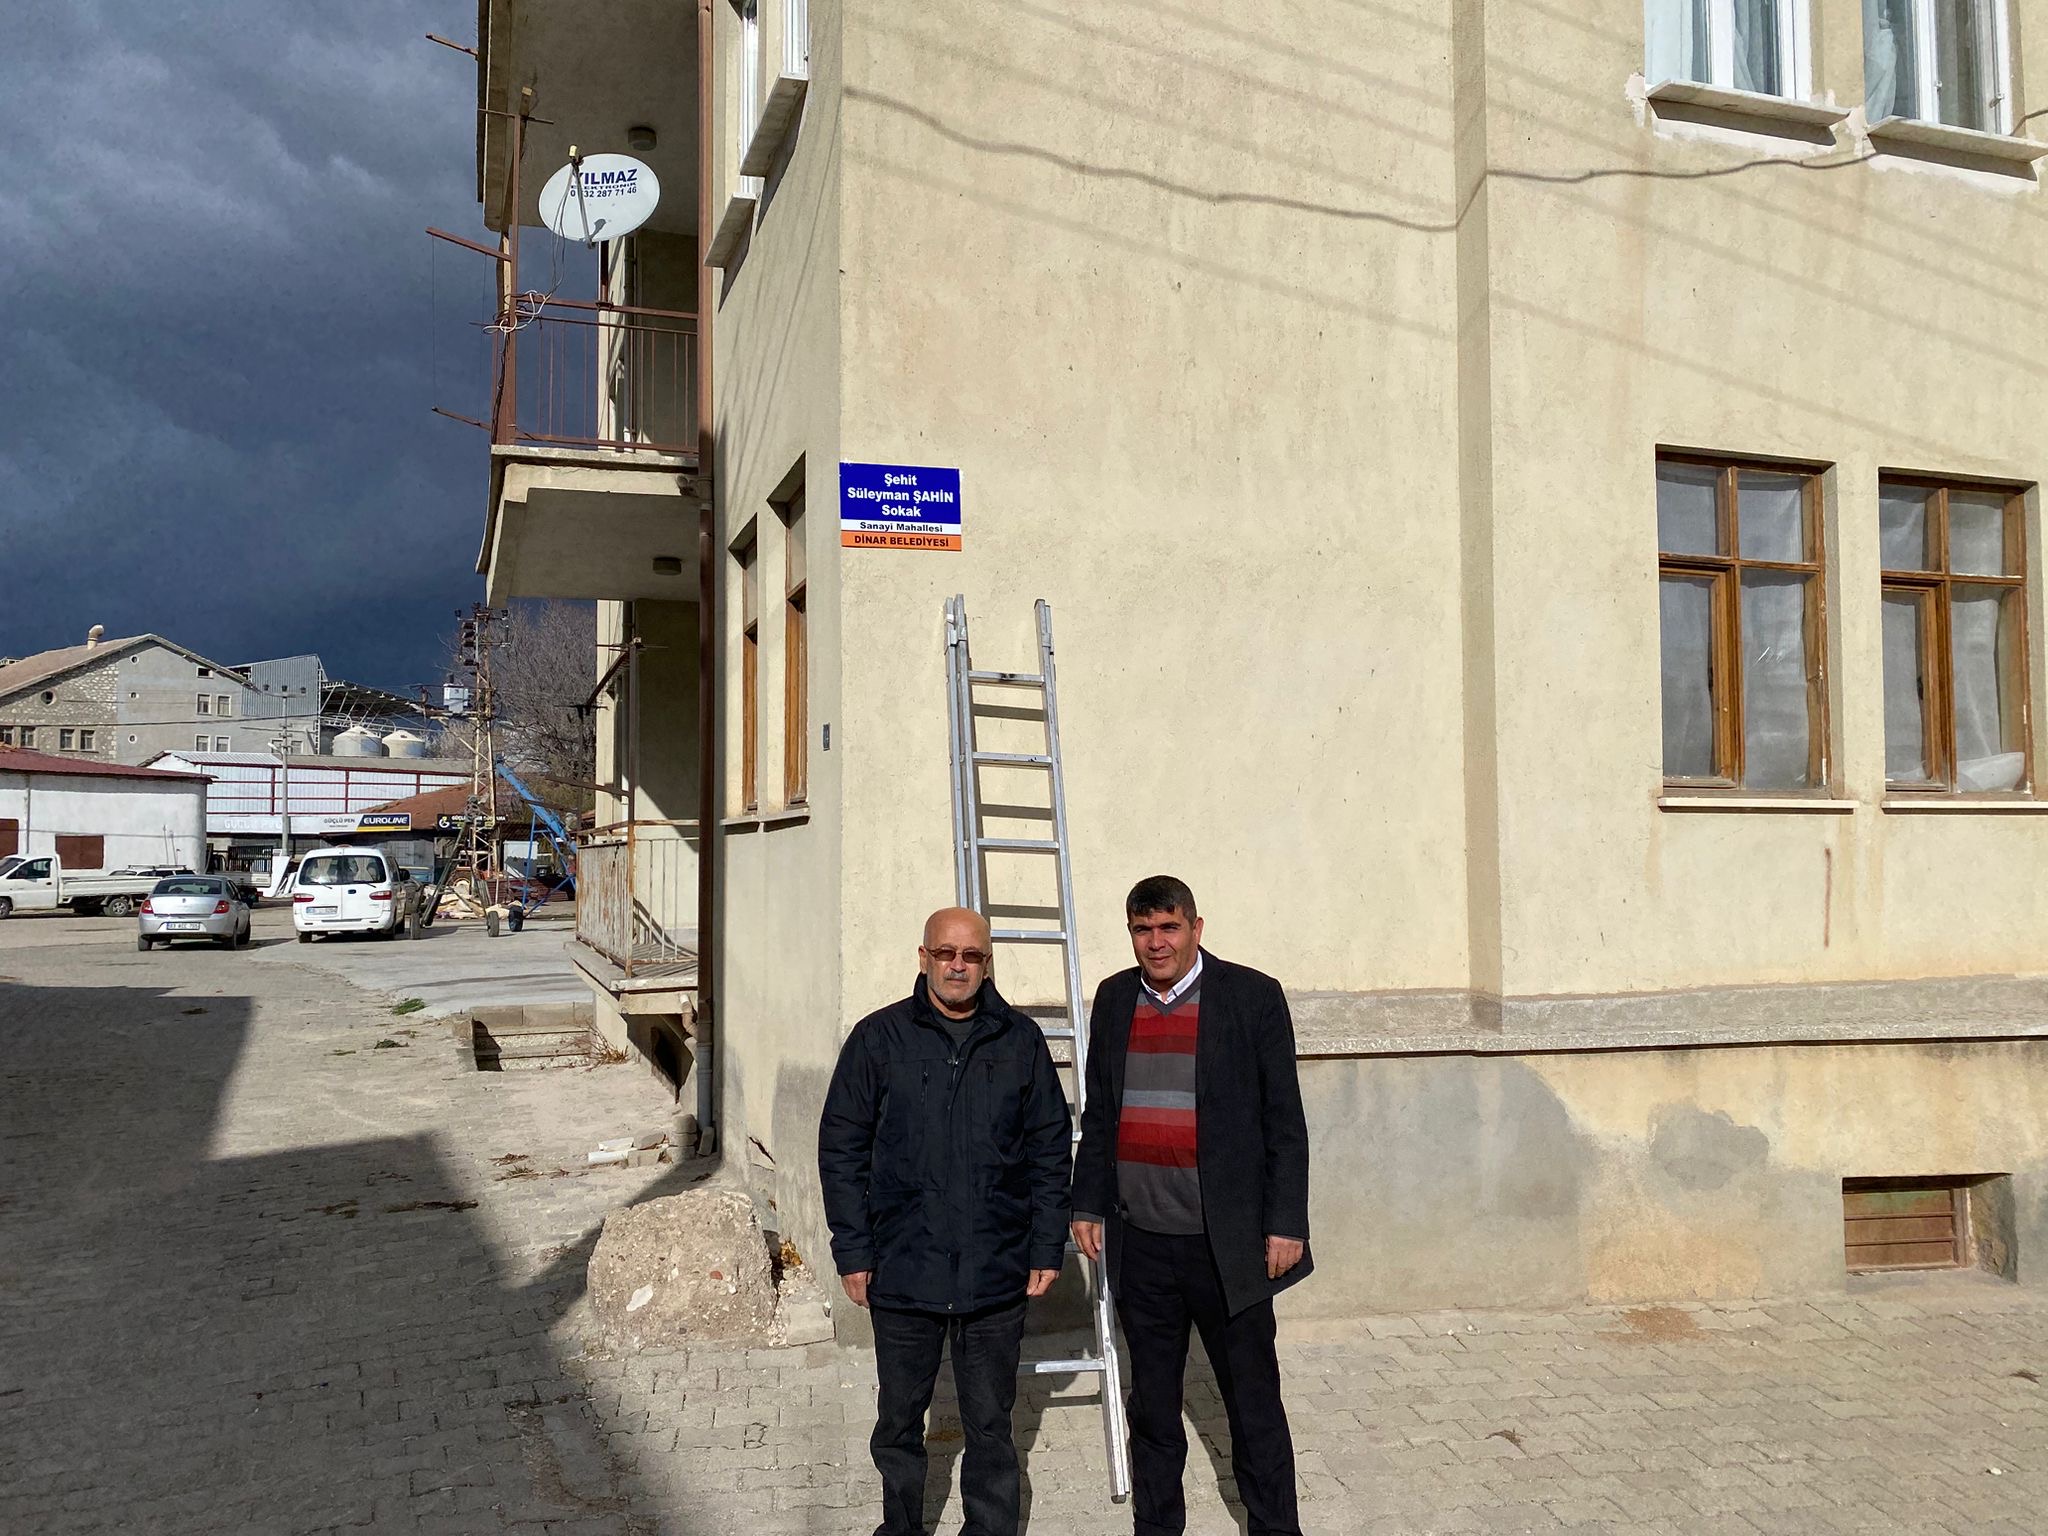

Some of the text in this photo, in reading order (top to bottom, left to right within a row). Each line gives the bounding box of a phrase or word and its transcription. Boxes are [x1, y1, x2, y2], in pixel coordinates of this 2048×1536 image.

[570, 186, 637, 198] 0 32 287 71 46
[884, 473, 917, 487] Şehit
[847, 487, 954, 504] Süleyman ŞAHİN
[881, 504, 921, 517] Sokak
[859, 521, 943, 533] Sanayi Mahallesi
[854, 533, 949, 547] DİNAR BELEDİYESİ
[363, 816, 408, 824] EUROLINE
